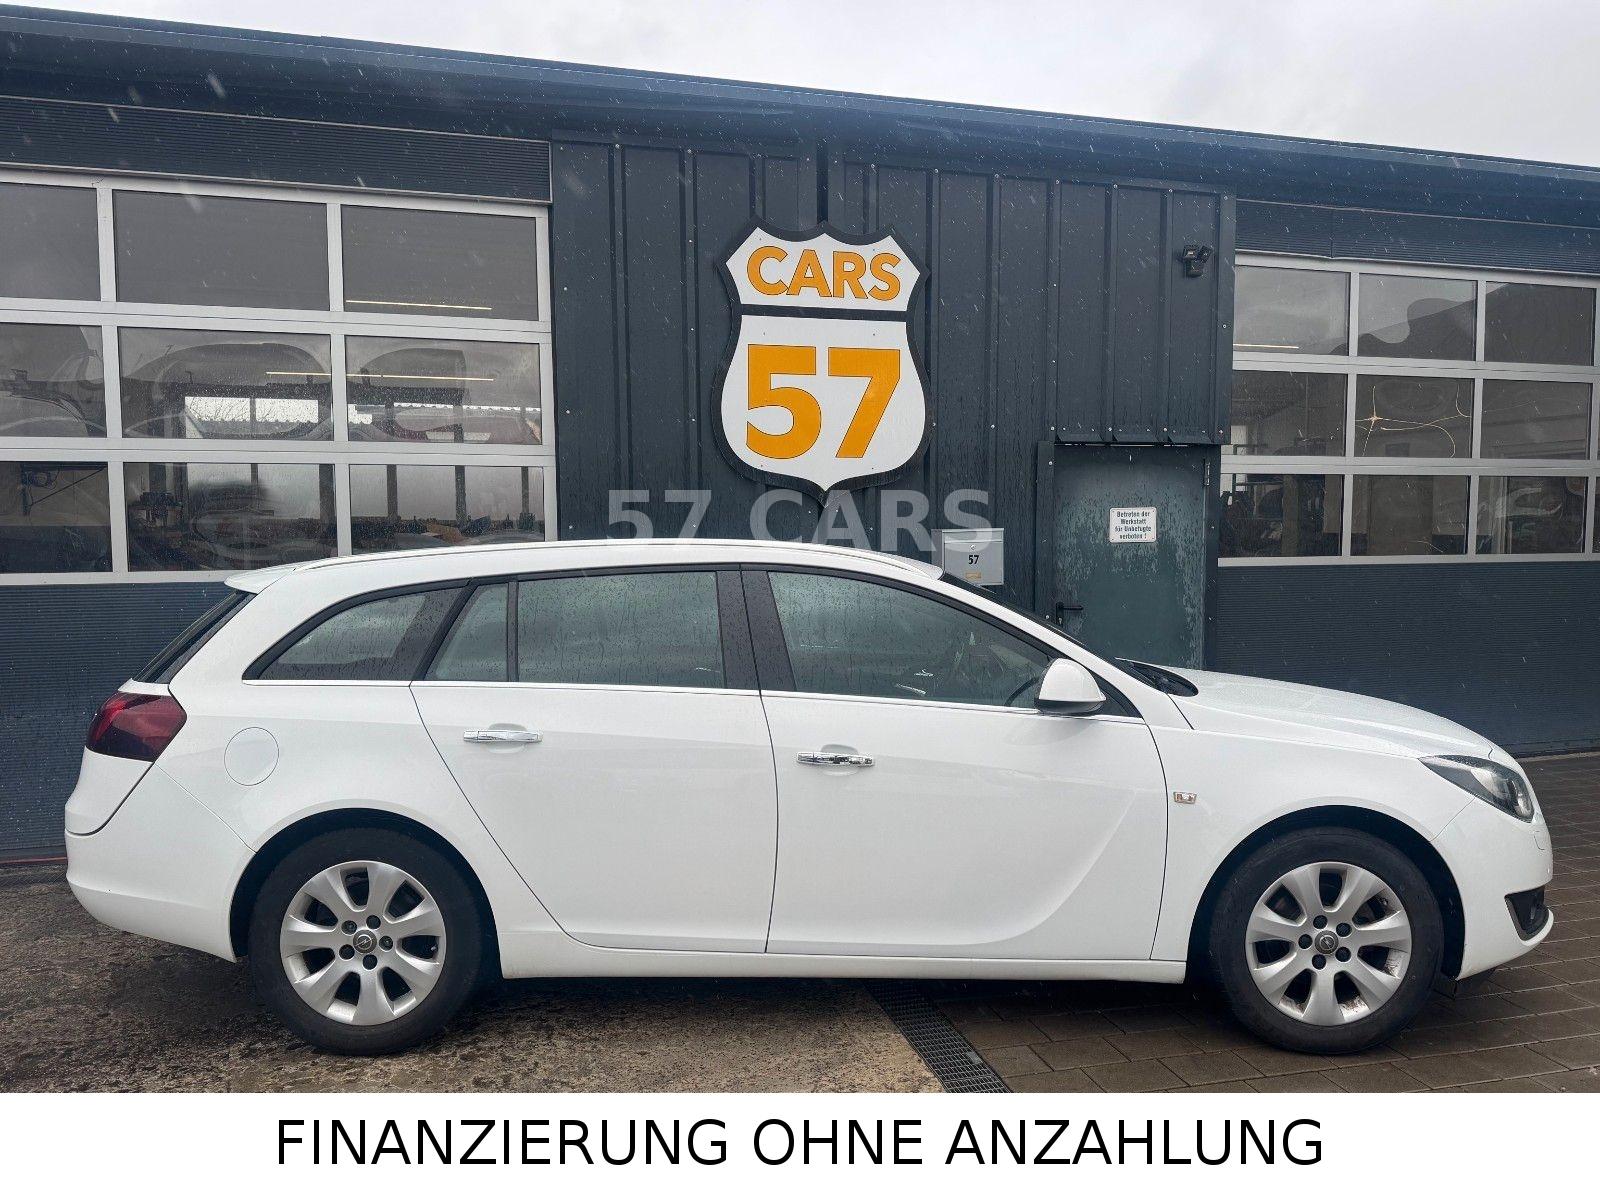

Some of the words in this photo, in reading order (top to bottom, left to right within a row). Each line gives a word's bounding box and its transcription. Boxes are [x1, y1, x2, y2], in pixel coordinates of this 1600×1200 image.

[747, 246, 901, 301] CARS
[746, 344, 901, 459] 57
[968, 555, 979, 565] 57
